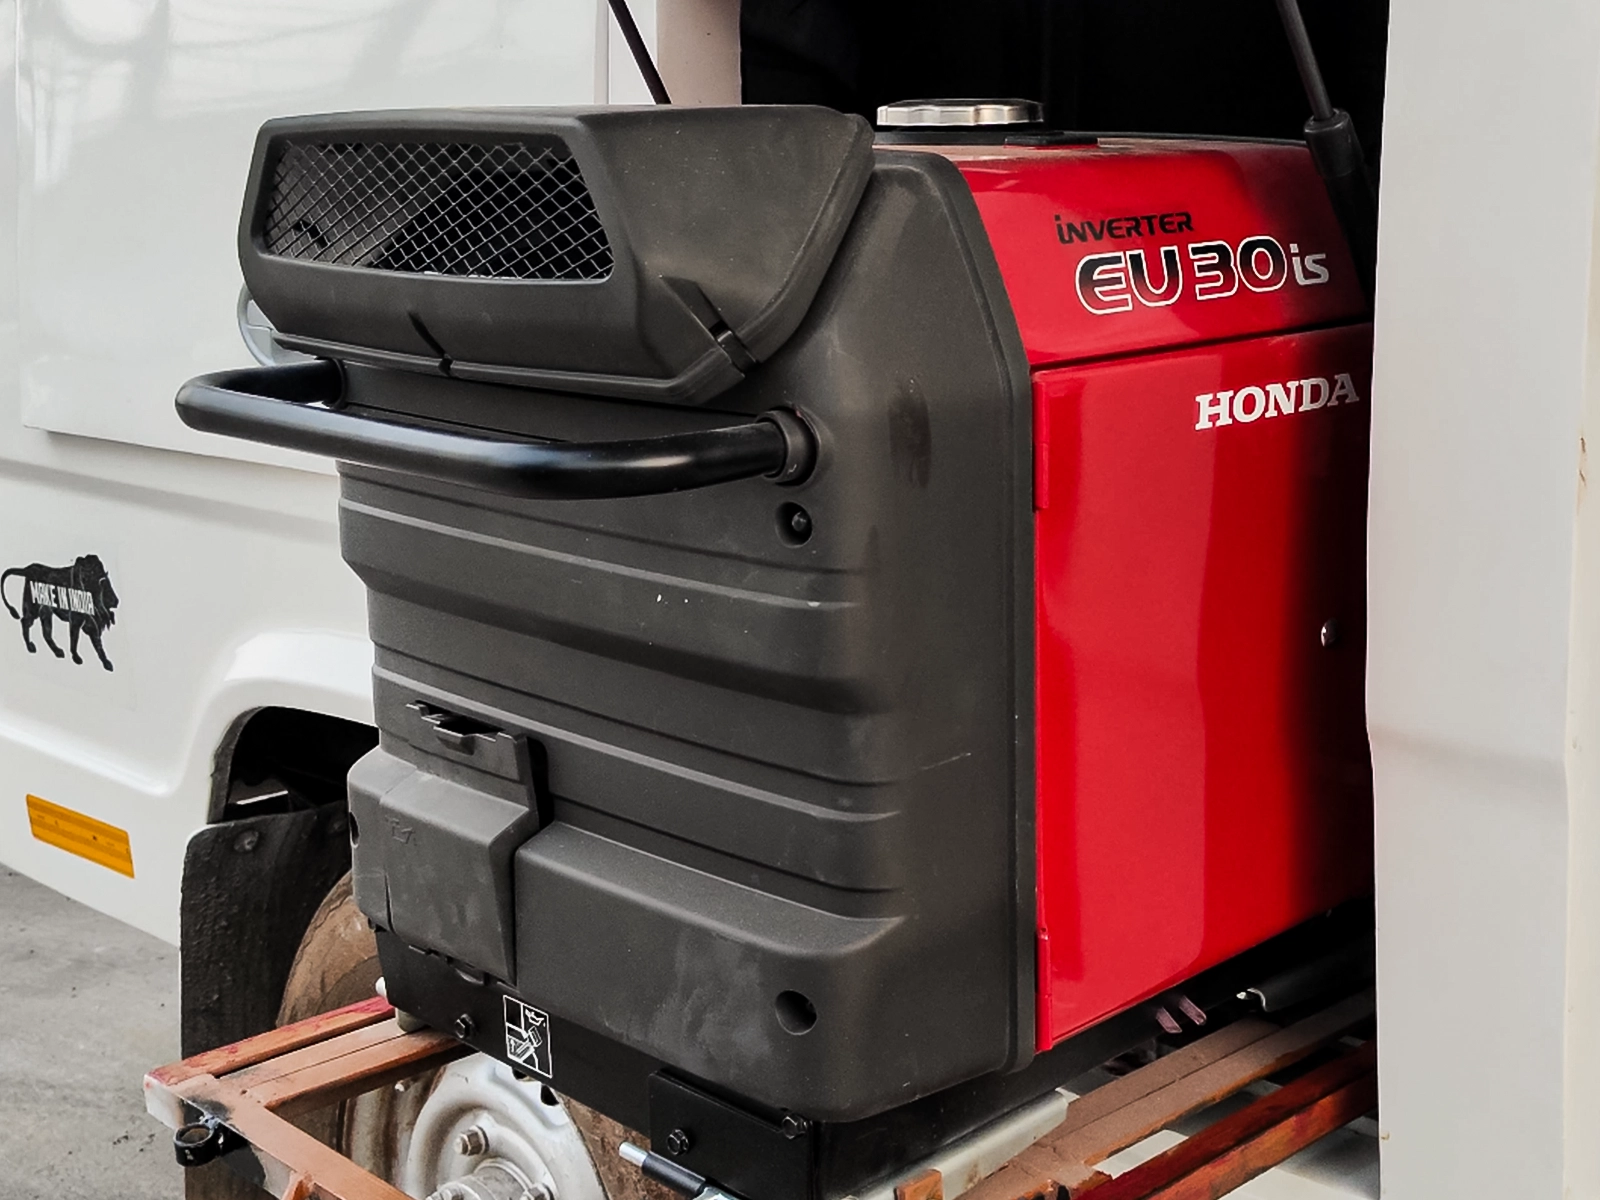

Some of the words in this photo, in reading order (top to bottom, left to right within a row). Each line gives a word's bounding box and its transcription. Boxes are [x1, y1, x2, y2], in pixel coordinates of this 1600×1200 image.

[1195, 373, 1359, 430] HONDA
[29, 580, 57, 607] MAKE
[57, 586, 69, 610] IN
[67, 588, 95, 615] INDIA
